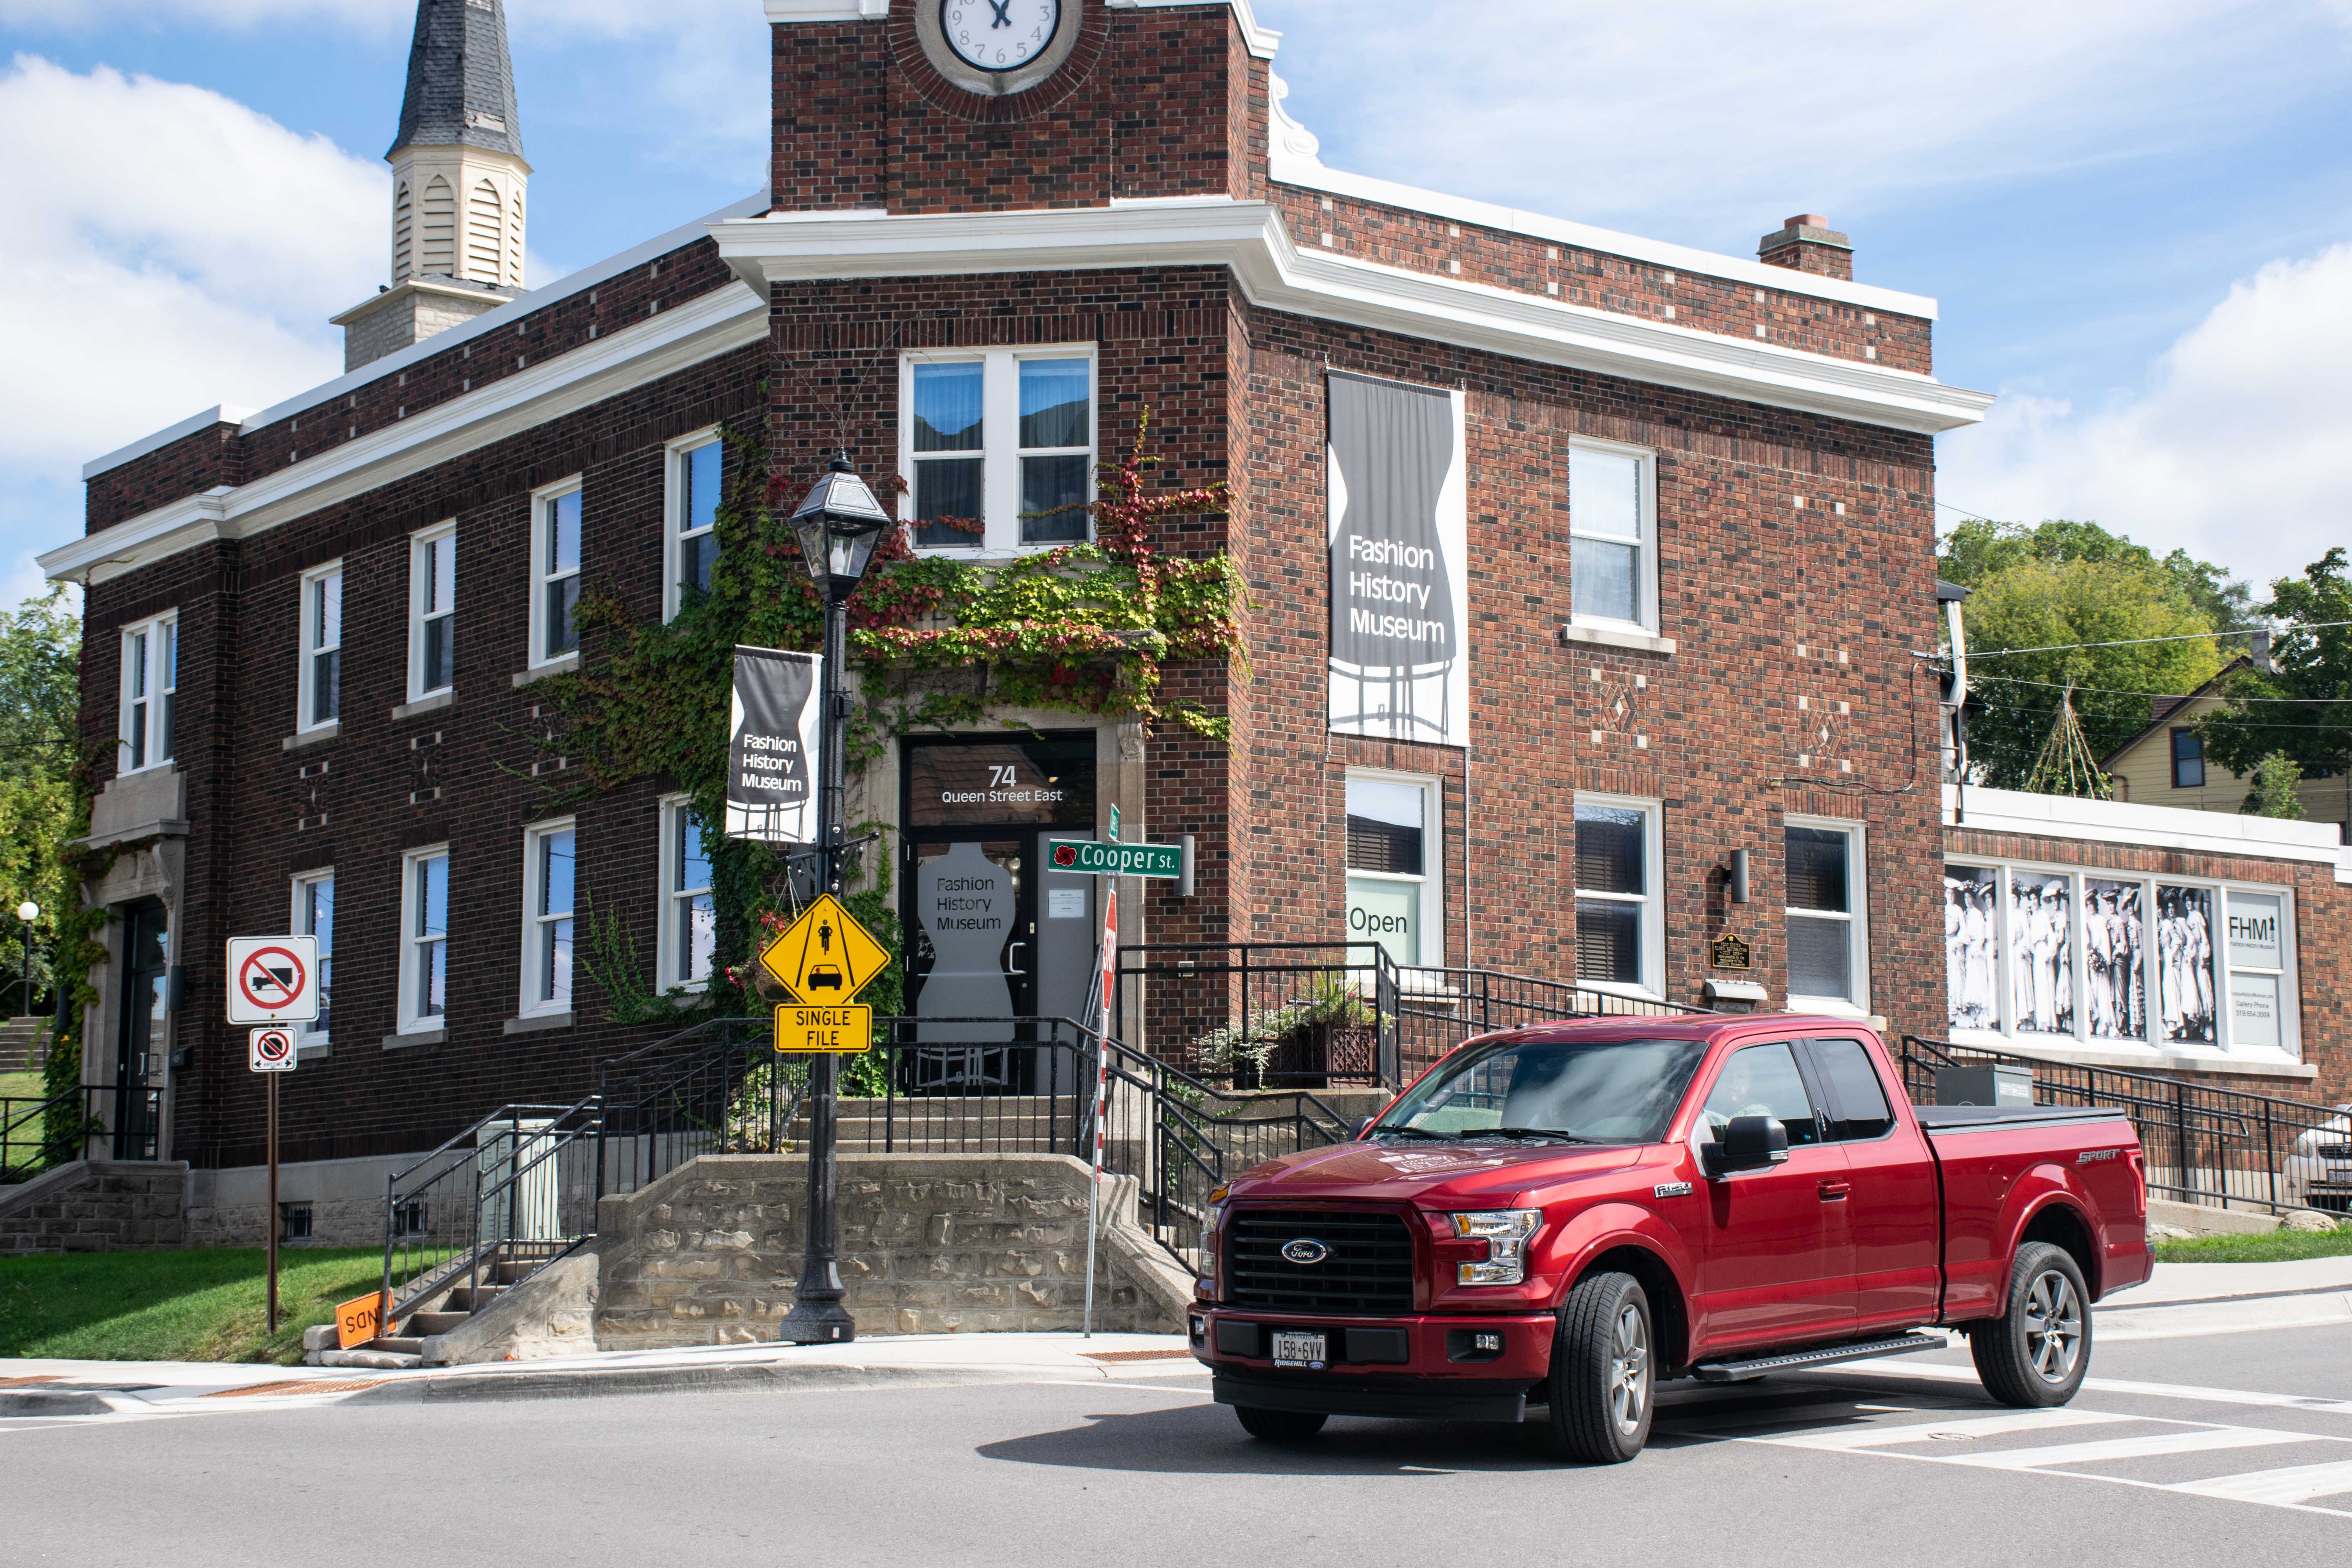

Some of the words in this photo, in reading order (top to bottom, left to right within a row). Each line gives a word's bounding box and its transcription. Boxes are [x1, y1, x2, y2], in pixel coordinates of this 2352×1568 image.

[952, 11, 962, 25] 9
[1039, 6, 1049, 21] 3
[960, 30, 969, 45] 8
[1030, 26, 1042, 41] 4
[975, 44, 985, 59] 7
[996, 48, 1006, 63] 6
[1016, 43, 1027, 58] 5
[1350, 535, 1434, 570] Fashion
[1350, 571, 1430, 609] History
[1350, 608, 1444, 643] Museum
[744, 734, 797, 753] Fashion
[743, 754, 793, 774] History
[742, 773, 802, 792] Museum
[989, 766, 1016, 787] 74
[942, 791, 985, 803] Queen
[989, 790, 1031, 802] Street
[1035, 789, 1062, 801] East
[1081, 845, 1155, 873] Cooper
[1159, 855, 1174, 868] St.
[937, 877, 994, 891] Fashion
[937, 897, 991, 912] History
[937, 917, 1001, 930] Museum
[1350, 907, 1407, 936] Open
[2229, 916, 2267, 941] FHM
[1104, 927, 1116, 973] STOP
[796, 1011, 850, 1026] SINGLE
[808, 1031, 839, 1045] FILE
[2076, 1149, 2120, 1165] SPORT
[1291, 1245, 1314, 1258] Ford
[346, 1306, 382, 1333] NDS
[1274, 1359, 1307, 1367] RIDGEHILL
